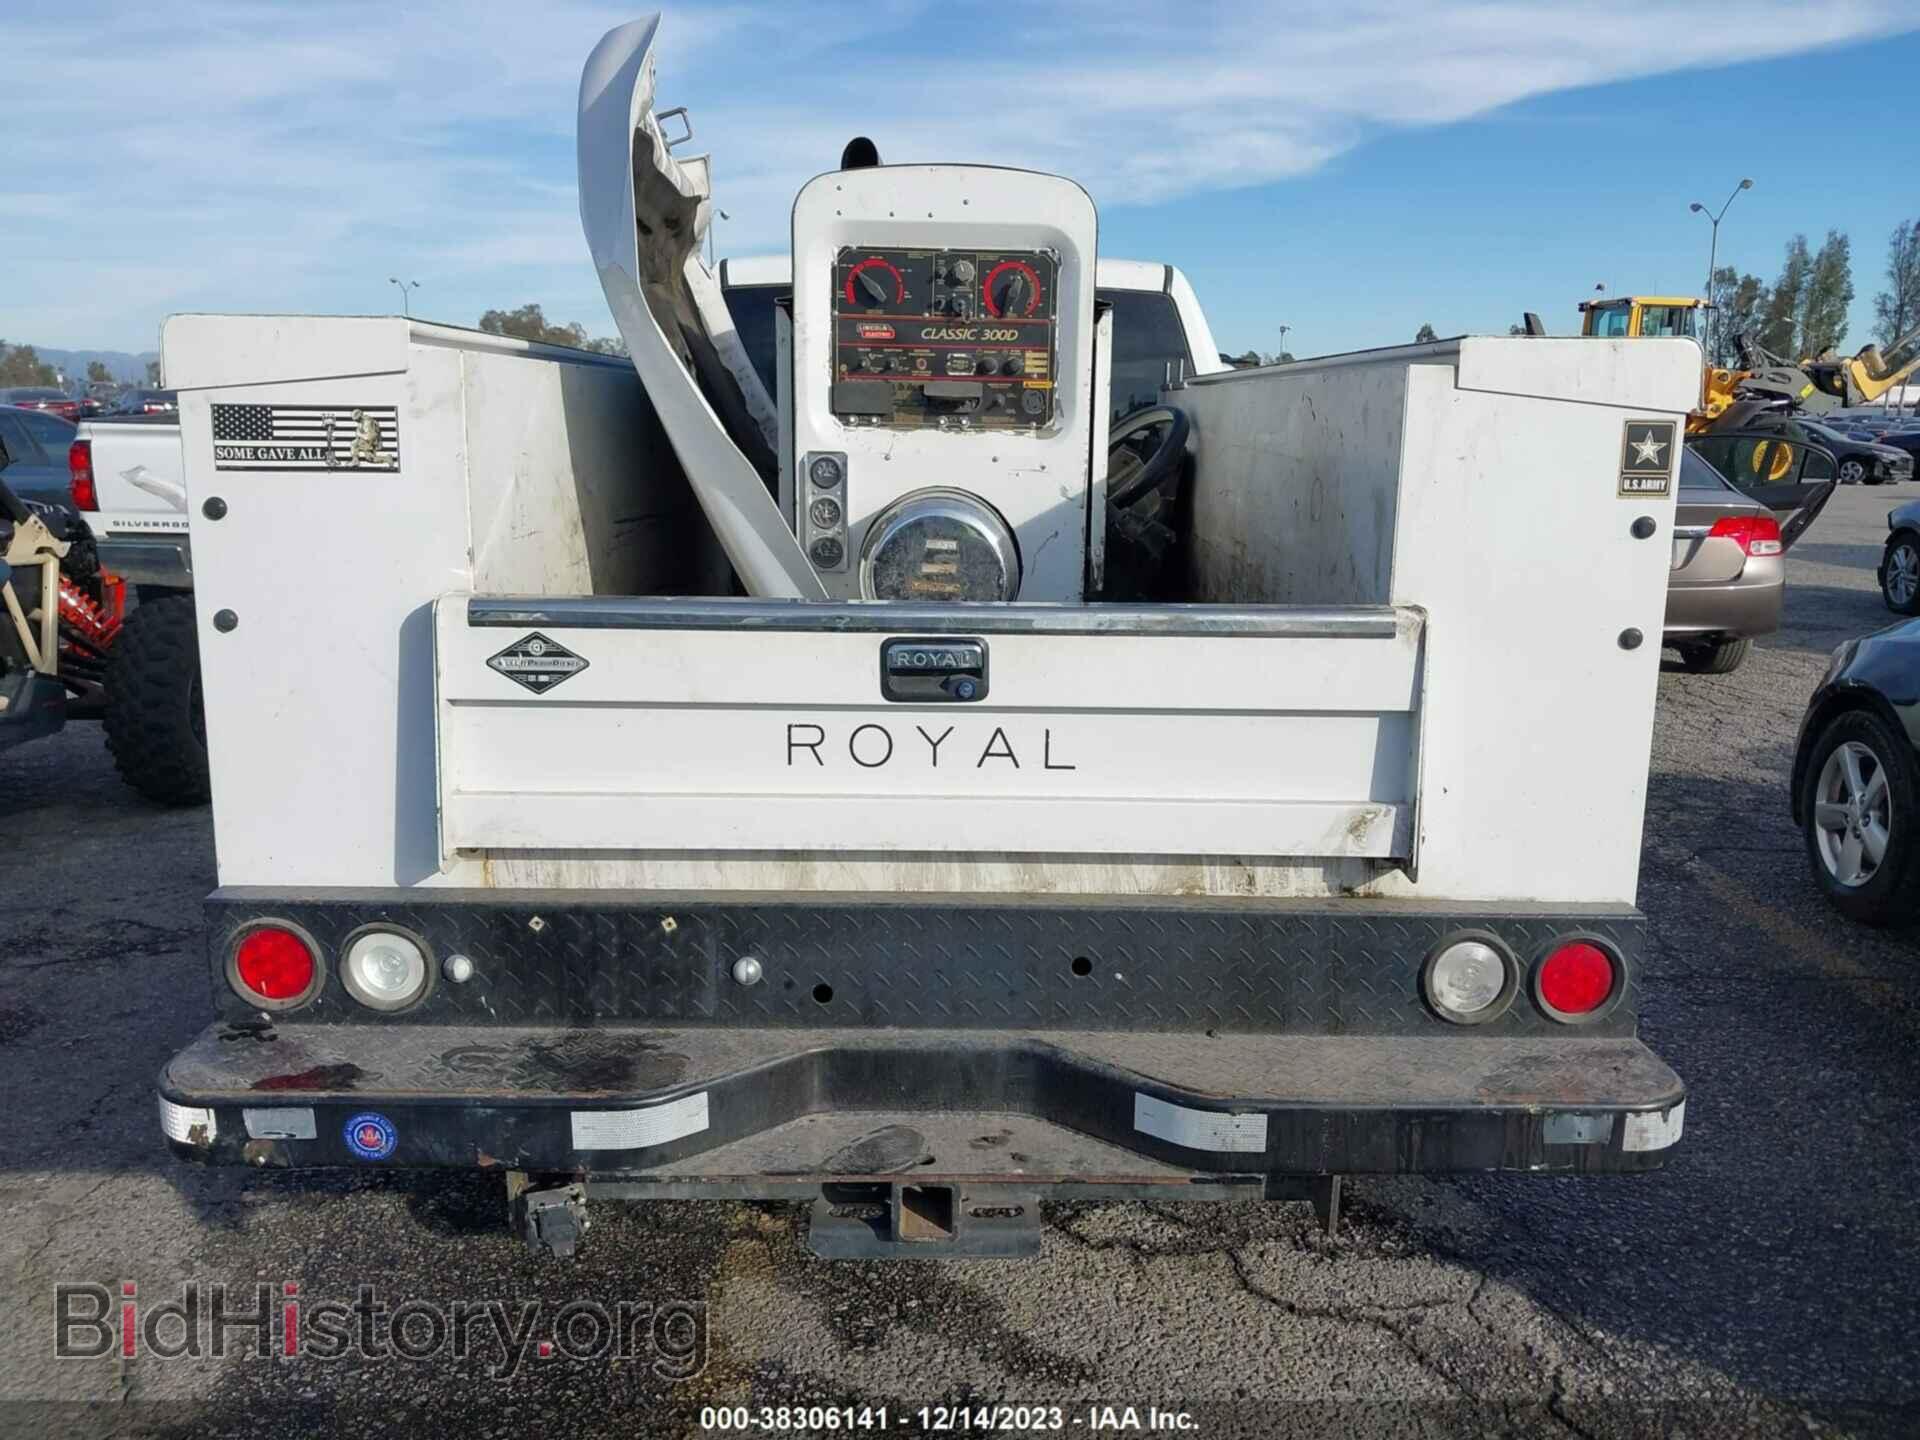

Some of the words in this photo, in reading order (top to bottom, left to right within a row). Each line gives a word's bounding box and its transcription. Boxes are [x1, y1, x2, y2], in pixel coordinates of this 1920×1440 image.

[920, 327, 978, 340] CLASSIC
[981, 328, 1018, 341] 300D
[215, 447, 256, 460] SOME
[257, 447, 296, 460] GAVE
[299, 447, 326, 460] ALL
[897, 651, 971, 666] ROYAL
[787, 723, 1076, 770] ROYAL
